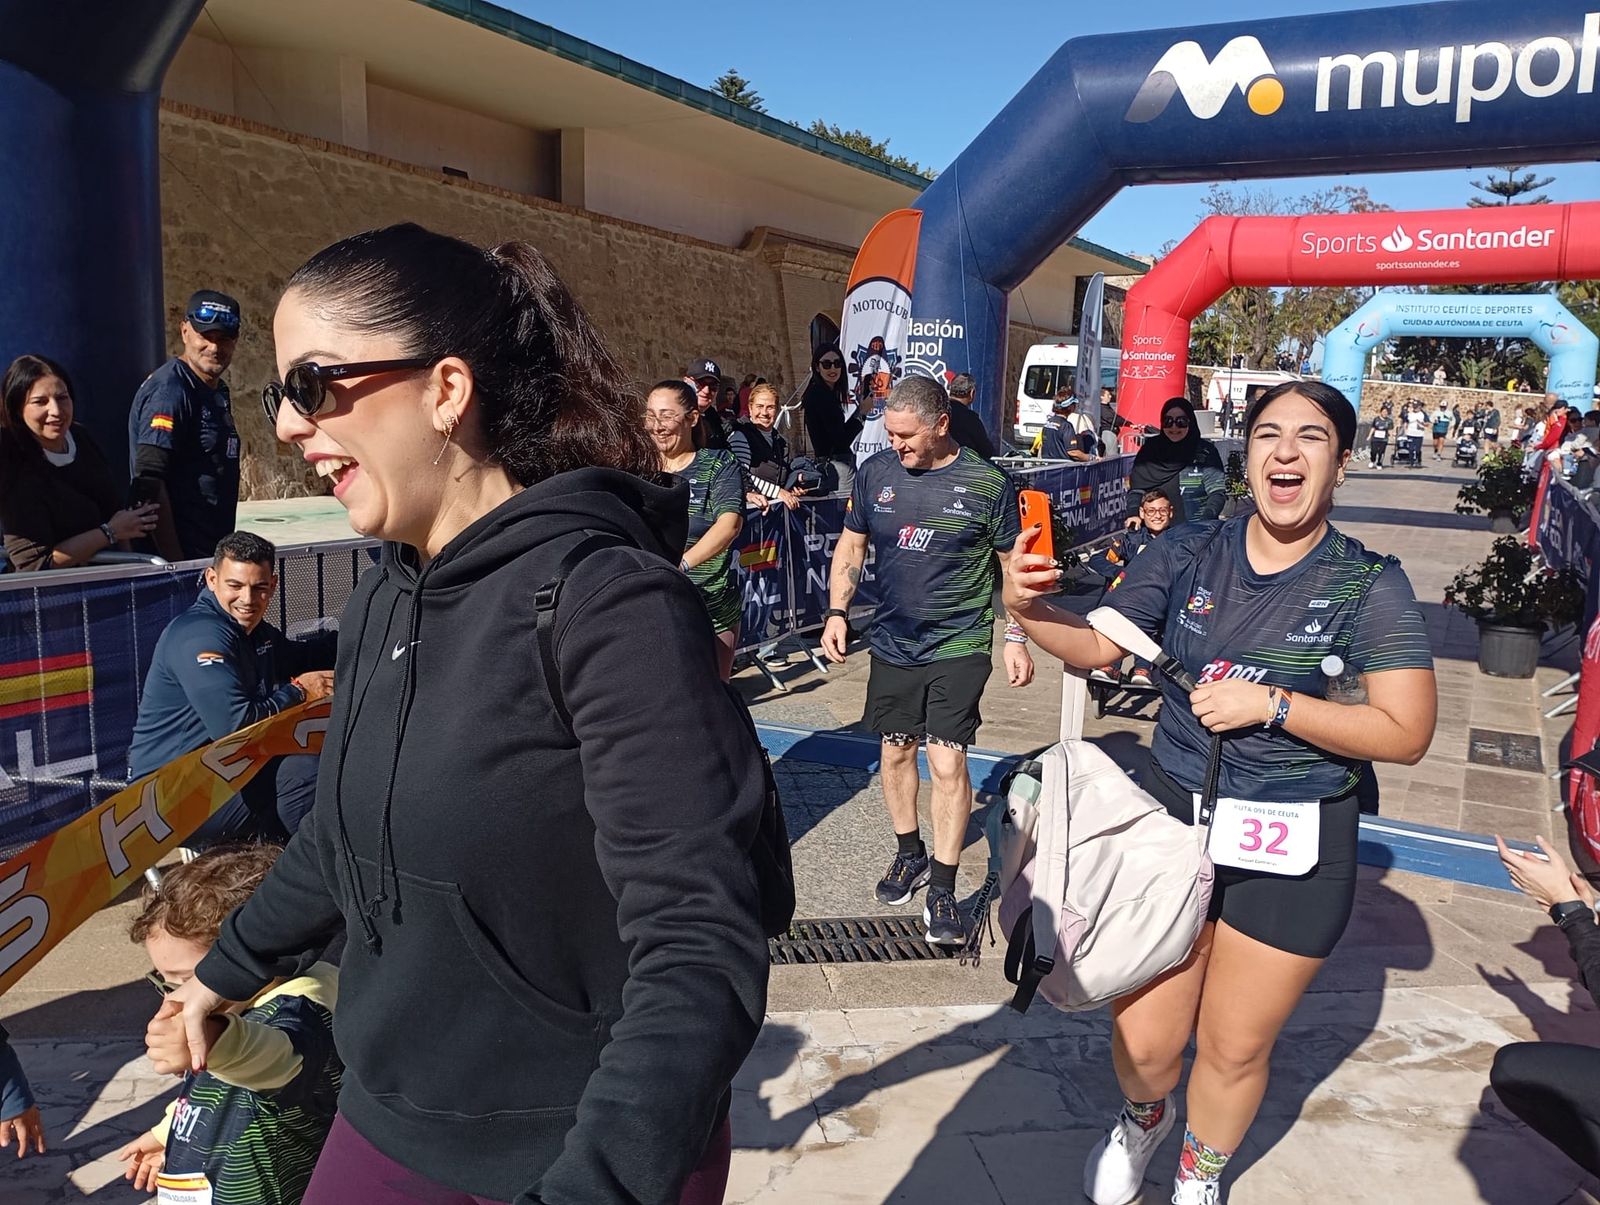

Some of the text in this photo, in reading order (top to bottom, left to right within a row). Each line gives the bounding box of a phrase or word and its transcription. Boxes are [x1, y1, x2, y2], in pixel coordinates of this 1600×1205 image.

[1301, 226, 1555, 258] Sports Santander
[1376, 260, 1460, 271] sportssantander.es
[852, 299, 909, 320] MOTOCLUB
[1395, 304, 1533, 314] INSTITUTO CEUTÍ DE DEPORTES
[1434, 319, 1480, 327] AUTÓNOMA
[1132, 335, 1162, 346] Sports
[1129, 350, 1176, 361] Santander
[942, 507, 972, 518] Santander
[1278, 810, 1299, 818] CEUTA
[1239, 818, 1289, 856] 32
